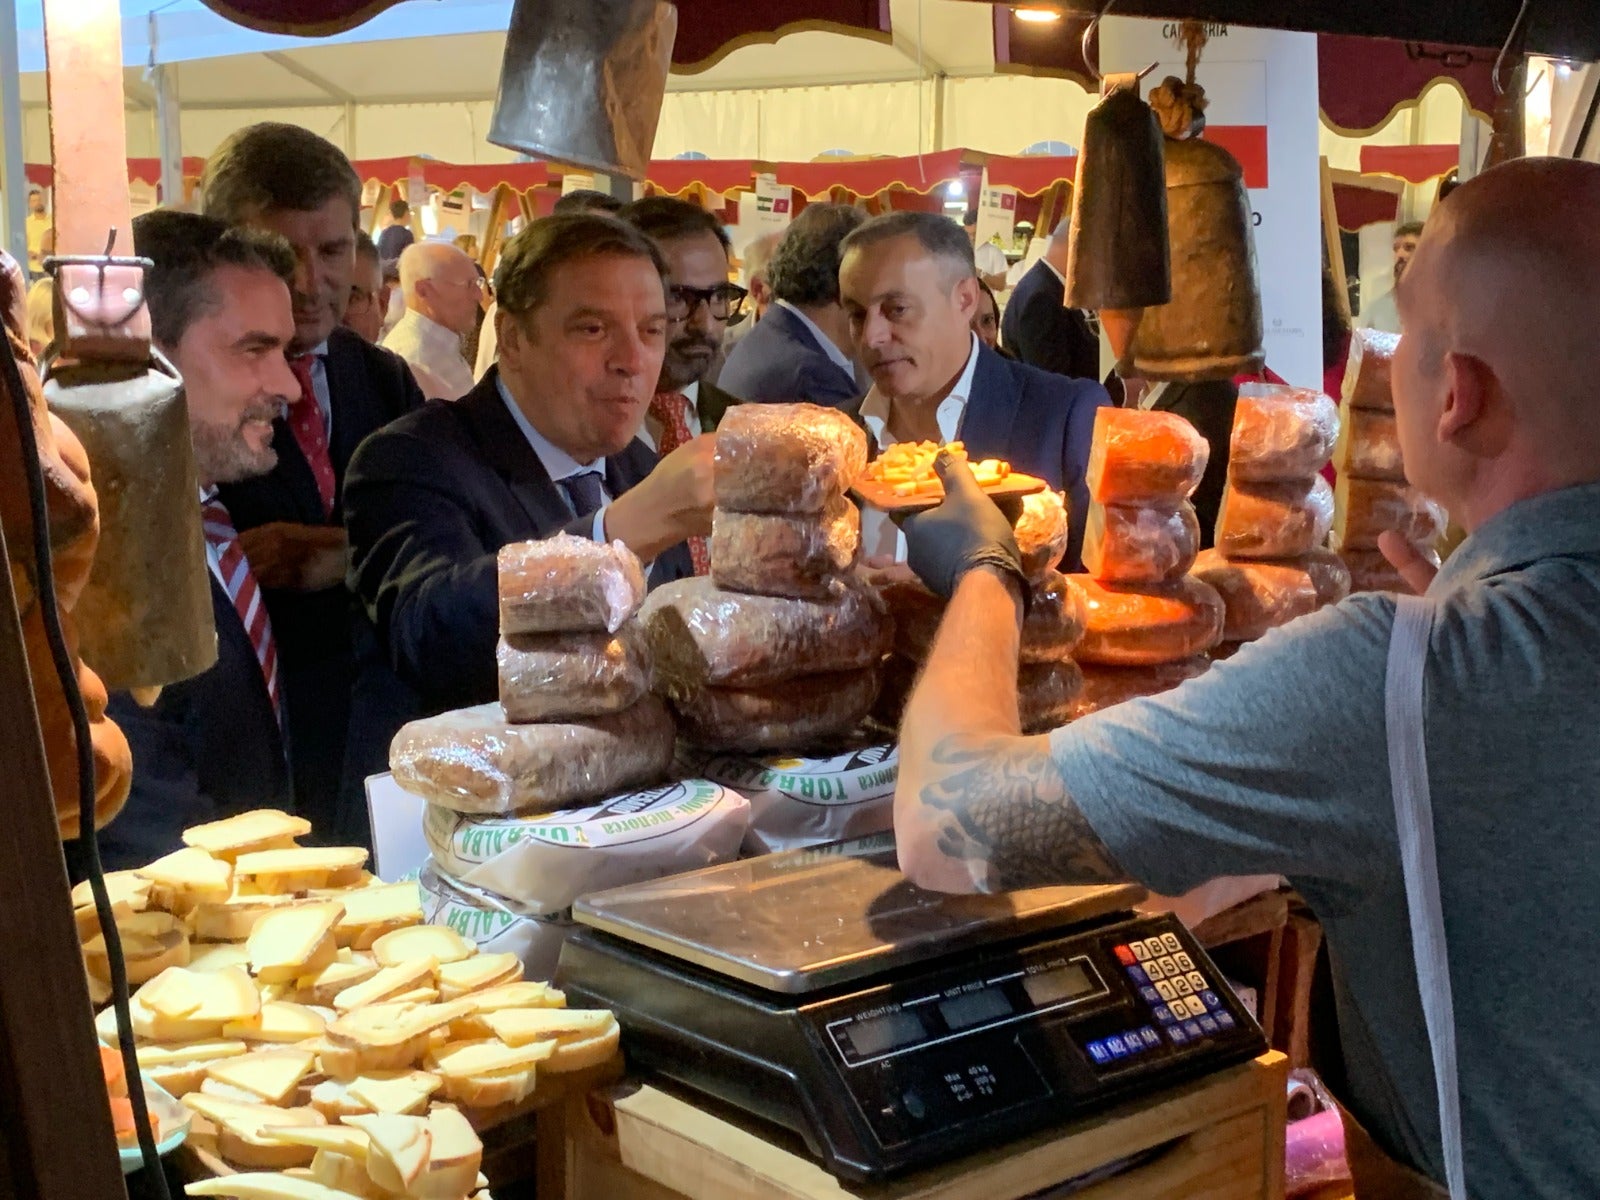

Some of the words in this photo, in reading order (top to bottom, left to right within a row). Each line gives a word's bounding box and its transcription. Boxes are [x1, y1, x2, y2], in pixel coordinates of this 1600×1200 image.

[1133, 944, 1145, 959] 7
[1150, 940, 1162, 954] 8
[1166, 935, 1178, 949] 9
[1149, 965, 1160, 979] 4
[1163, 959, 1176, 973] 5
[1179, 955, 1191, 968] 6
[1175, 979, 1188, 993] 2
[1191, 974, 1204, 988] 3
[1174, 1001, 1187, 1016] 0
[1089, 1044, 1110, 1062] M1
[1107, 1037, 1127, 1055] M2
